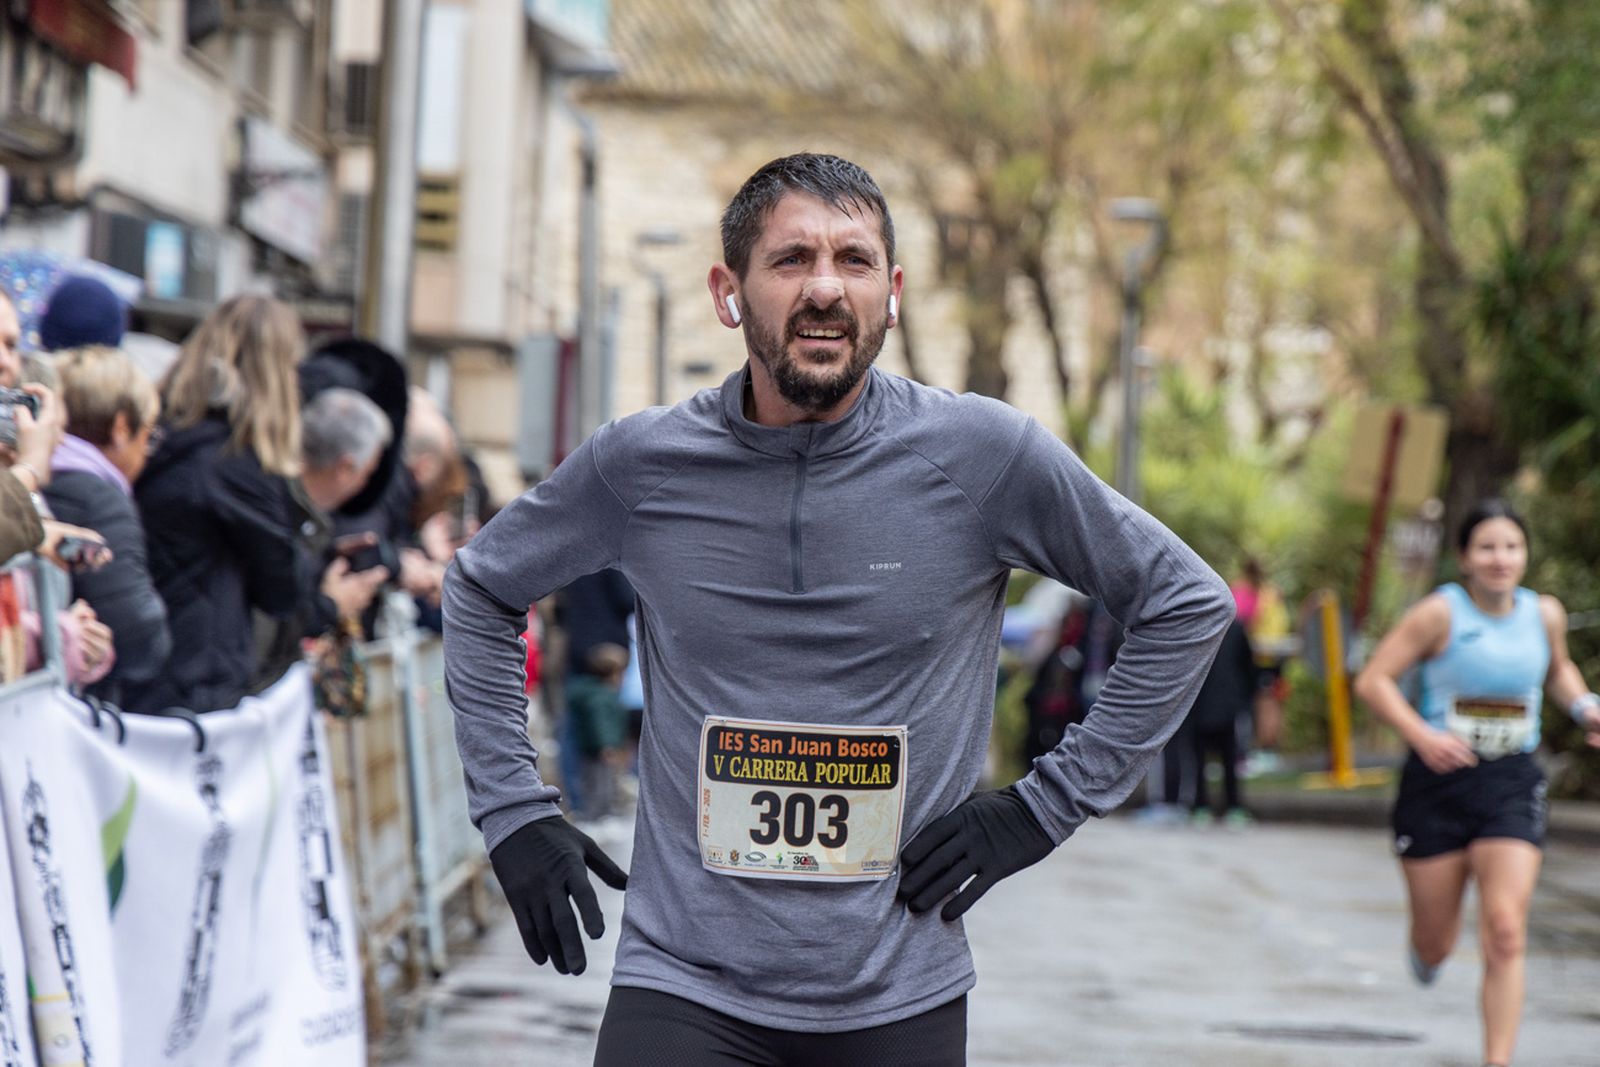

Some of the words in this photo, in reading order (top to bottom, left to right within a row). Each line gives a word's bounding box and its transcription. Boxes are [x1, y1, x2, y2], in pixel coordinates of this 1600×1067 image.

[869, 562, 902, 570] KIPRUN
[719, 732, 743, 752] IES
[749, 734, 783, 754] San
[788, 736, 831, 756] Juan
[838, 738, 888, 758] Bosco
[713, 755, 724, 775] V
[729, 757, 808, 782] CARRERA
[815, 762, 891, 784] POPULAR
[749, 790, 850, 848] 303
